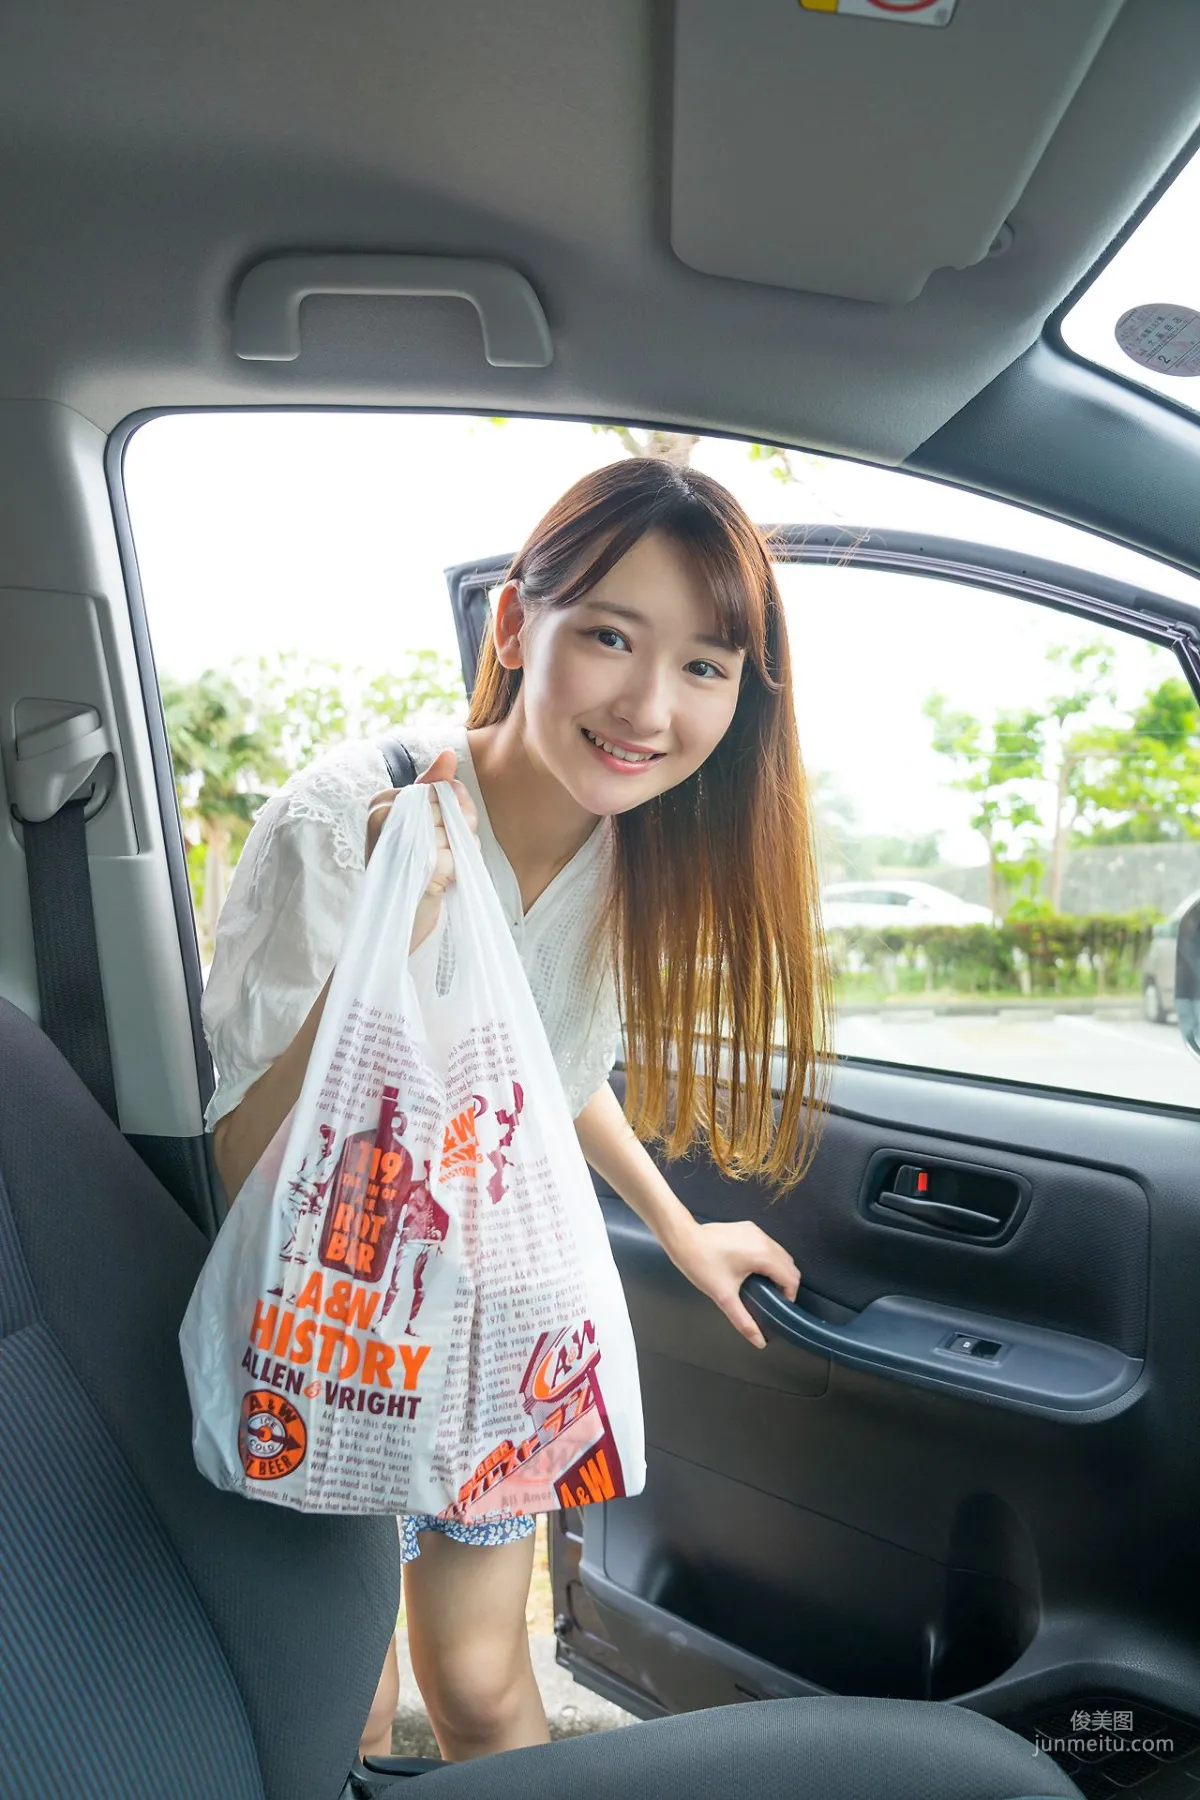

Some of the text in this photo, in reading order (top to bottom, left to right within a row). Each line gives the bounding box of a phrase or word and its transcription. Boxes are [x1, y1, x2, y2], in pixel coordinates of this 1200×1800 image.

[494, 1347, 527, 1363] believed
[241, 1346, 305, 1396] ALLEN
[492, 1398, 518, 1413] United
[260, 1416, 278, 1430] ICE
[363, 1417, 380, 1430] this
[402, 1424, 417, 1435] the
[344, 1426, 371, 1440] blend
[374, 1430, 384, 1441] of
[365, 1442, 383, 1455] and
[384, 1445, 413, 1461] berries
[341, 1465, 369, 1479] success
[370, 1469, 380, 1479] of
[381, 1471, 393, 1482] his
[561, 1449, 616, 1509] A&W
